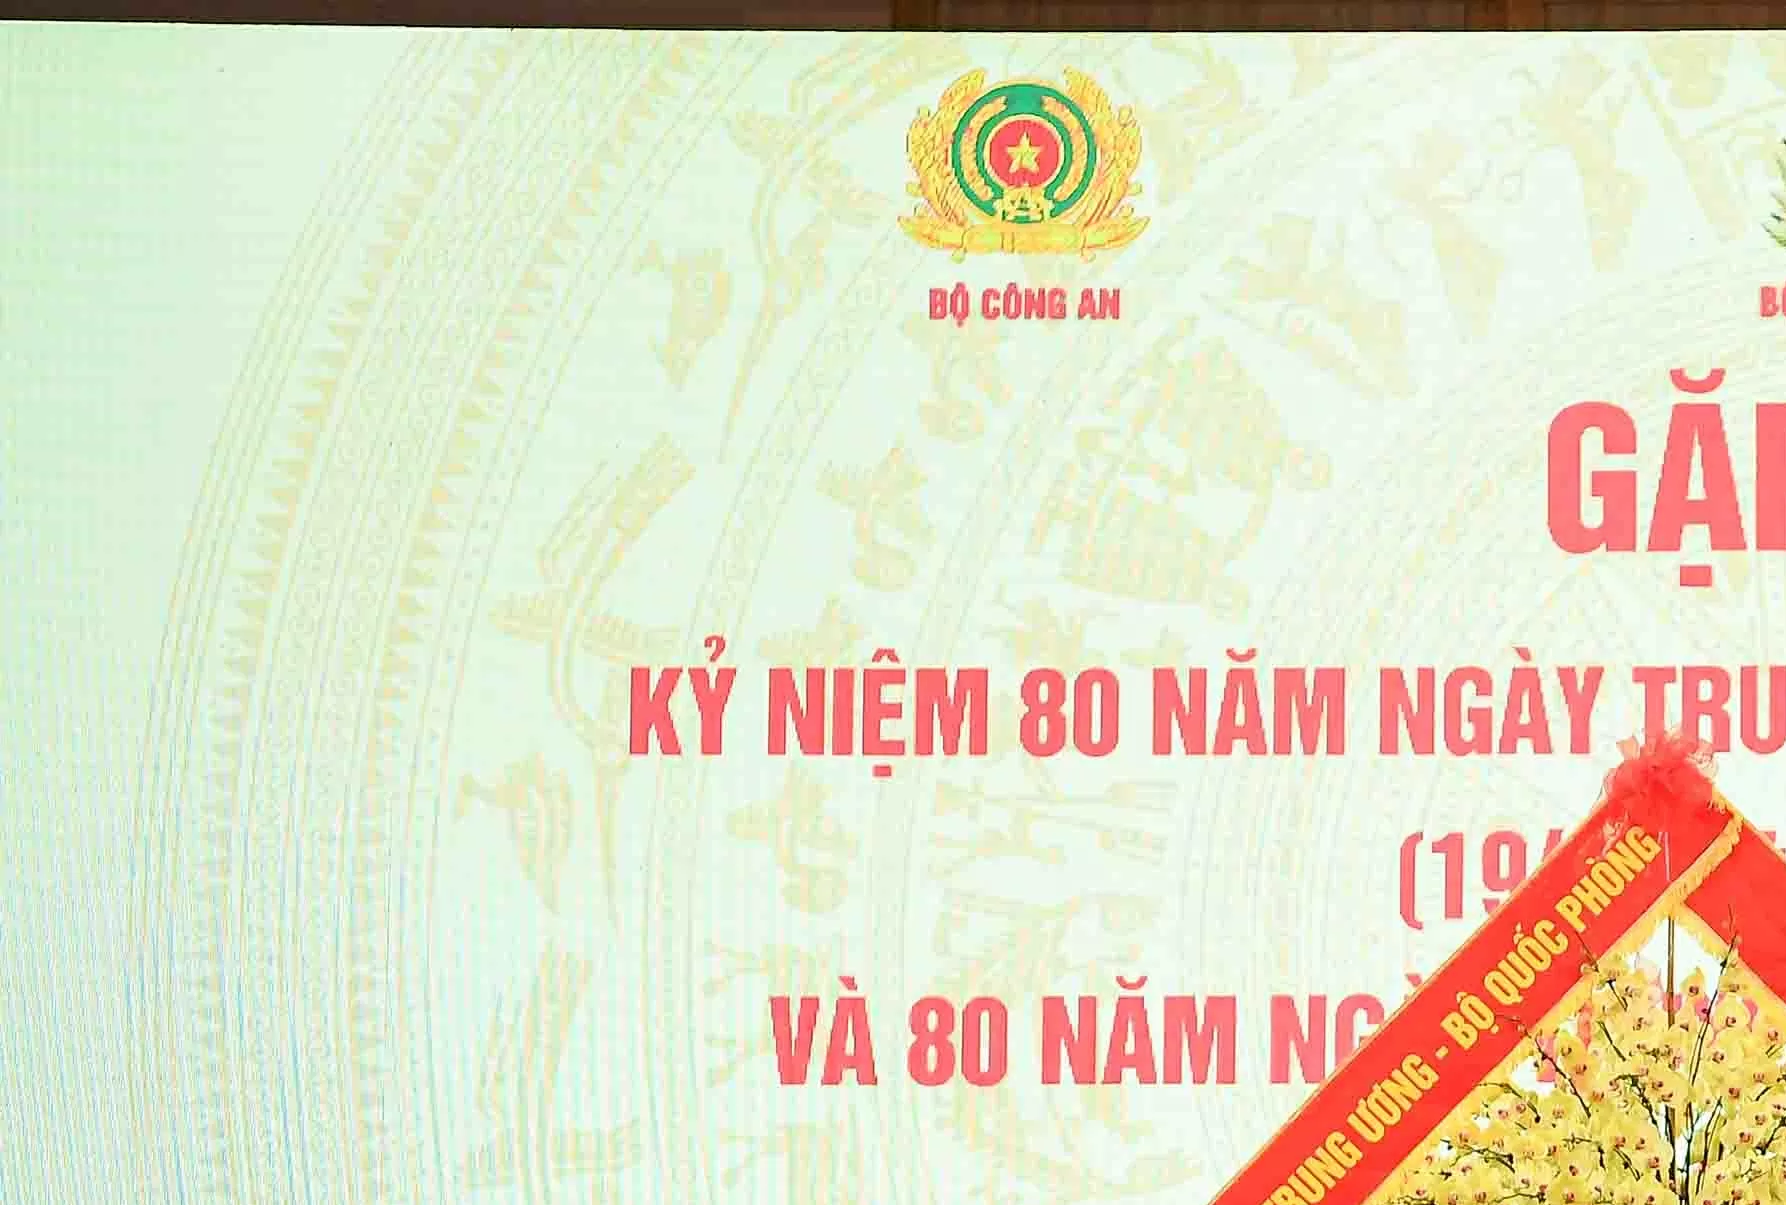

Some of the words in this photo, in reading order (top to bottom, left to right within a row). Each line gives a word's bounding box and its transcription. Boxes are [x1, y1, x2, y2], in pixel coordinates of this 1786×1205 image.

[929, 282, 971, 327] BỘ
[981, 282, 1067, 321] CÔNG
[1077, 287, 1121, 321] AN
[629, 634, 737, 756] KỶ
[767, 647, 989, 778] NIỆM
[1018, 666, 1121, 757] 80
[1151, 647, 1346, 756] NĂM
[1379, 646, 1605, 756] NGÀY
[769, 975, 877, 1086] VÀ
[906, 996, 1009, 1087] 80
[1040, 975, 1237, 1085] NĂM
[1346, 1051, 1439, 1150] ƯƠNG
[1440, 990, 1499, 1051] BỘ
[1485, 919, 1570, 1006] QUỐC
[1555, 823, 1662, 934] PHÒNG
